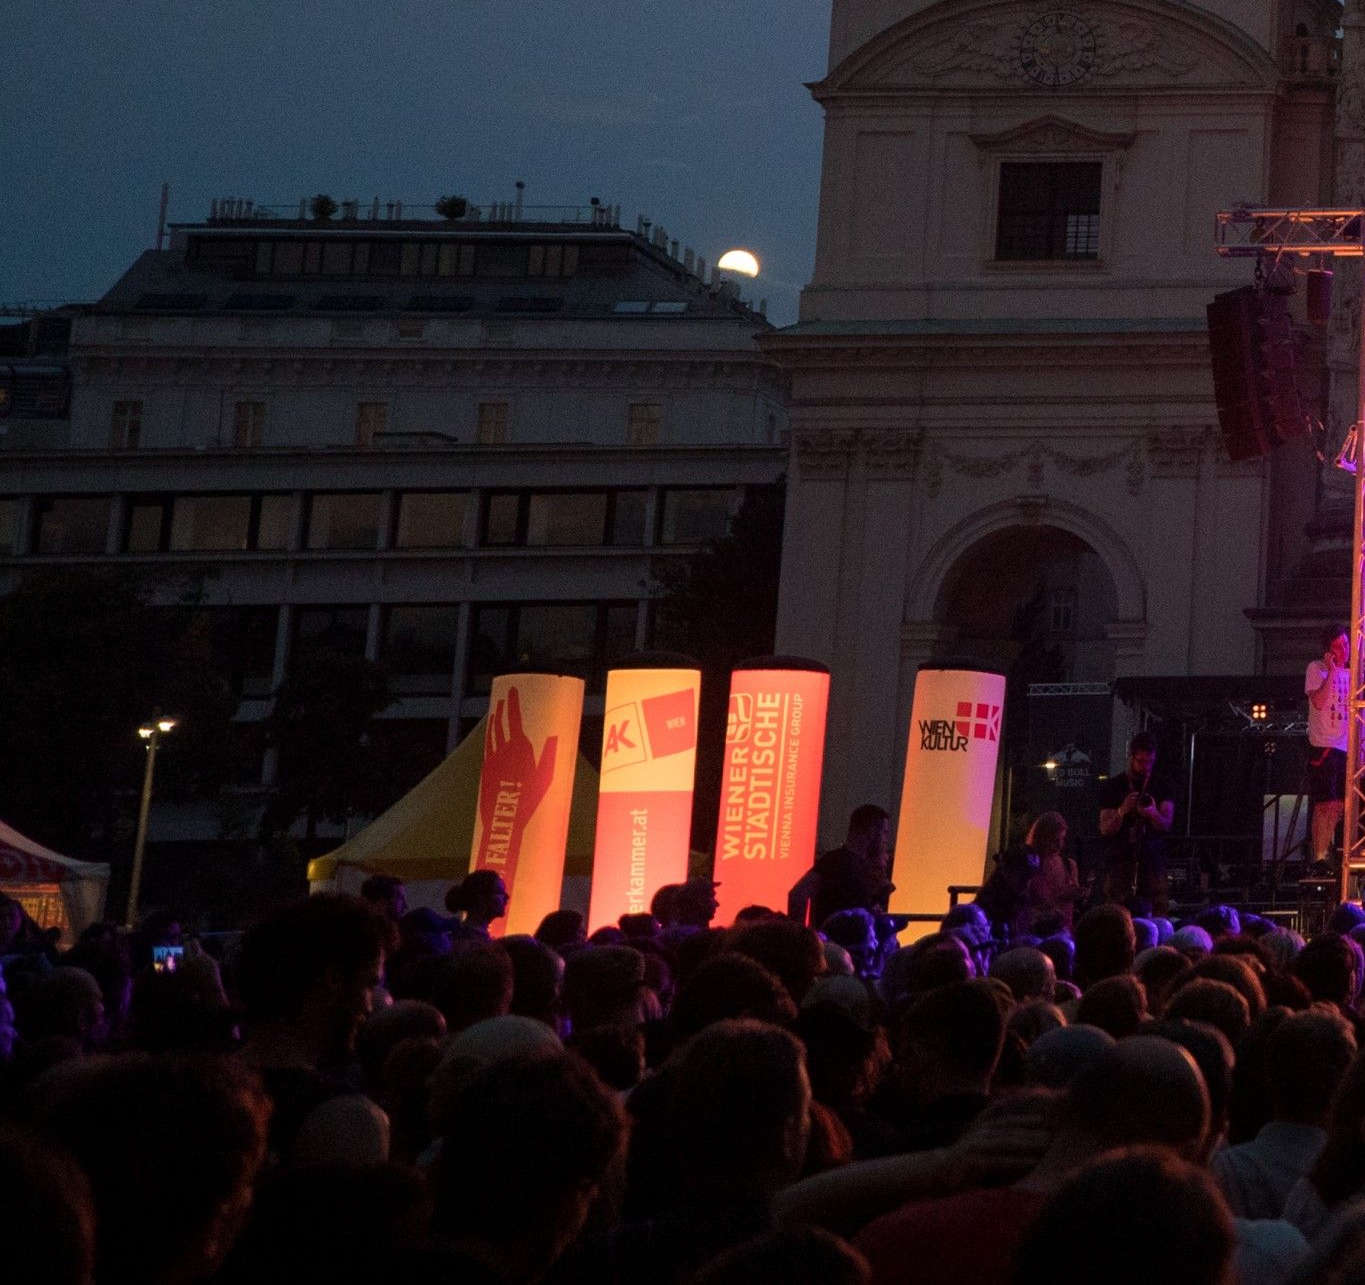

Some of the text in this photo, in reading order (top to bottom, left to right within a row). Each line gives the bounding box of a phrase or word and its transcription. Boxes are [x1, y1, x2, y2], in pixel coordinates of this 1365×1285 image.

[604, 719, 637, 758] AK
[665, 715, 687, 731] WIEN
[919, 720, 955, 735] WIEN
[920, 735, 969, 752] KULTUR
[722, 746, 750, 860] WIENER
[743, 692, 781, 860] STÄDTISCHE
[779, 693, 803, 859] VIENNA INSURANCE GROUP
[484, 779, 522, 866] FALTER!
